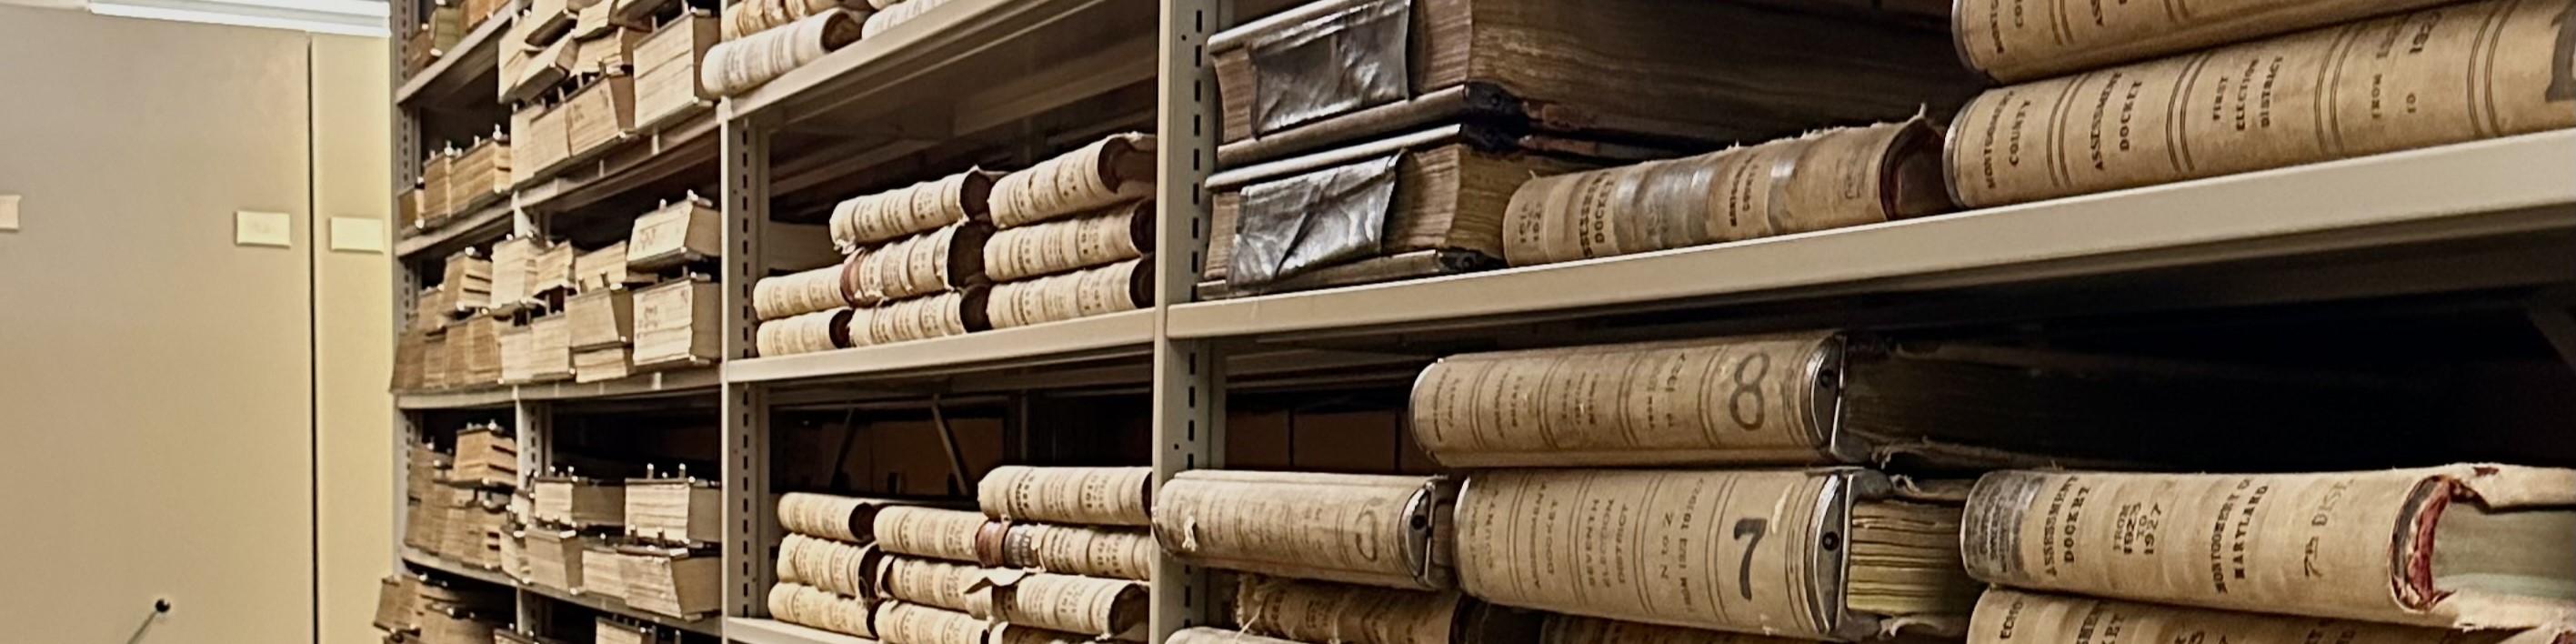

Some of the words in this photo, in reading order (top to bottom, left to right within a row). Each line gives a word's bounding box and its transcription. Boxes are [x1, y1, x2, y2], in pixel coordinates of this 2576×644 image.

[2090, 72, 2123, 171] ASSESSMENT
[2119, 80, 2144, 152] DOCKET
[2211, 75, 2230, 121] FIRST
[2236, 58, 2260, 131] ELECTION
[2260, 55, 2284, 129] DISTRICT
[2371, 73, 2384, 120] FROM
[2405, 93, 2418, 114] TO
[1983, 91, 2015, 189] MONTGOMERY
[2008, 99, 2031, 166] COUNTY
[1594, 178, 1616, 244] DOCKET
[1729, 351, 1770, 432] 8
[1486, 490, 1499, 569] COUNTY
[1529, 481, 1548, 589] ASSESSMENT
[1546, 498, 1559, 575] DOCKET
[1585, 498, 1600, 587] SEVENTH
[1599, 498, 1615, 589] ELECTION
[1615, 504, 1629, 584] DISTRICT
[1662, 511, 1674, 528] Z
[1680, 512, 1692, 529] TO
[2042, 474, 2079, 577] ASSESSMENT
[2062, 486, 2091, 565] DOCKET
[2112, 503, 2130, 552] FROM
[2136, 514, 2149, 541] TO
[2143, 502, 2161, 556] 1927
[2210, 492, 2240, 594] MONTGOMERY
[2232, 485, 2269, 580] MARYLAND
[1660, 565, 1669, 580] N
[1734, 517, 1768, 602] 7
